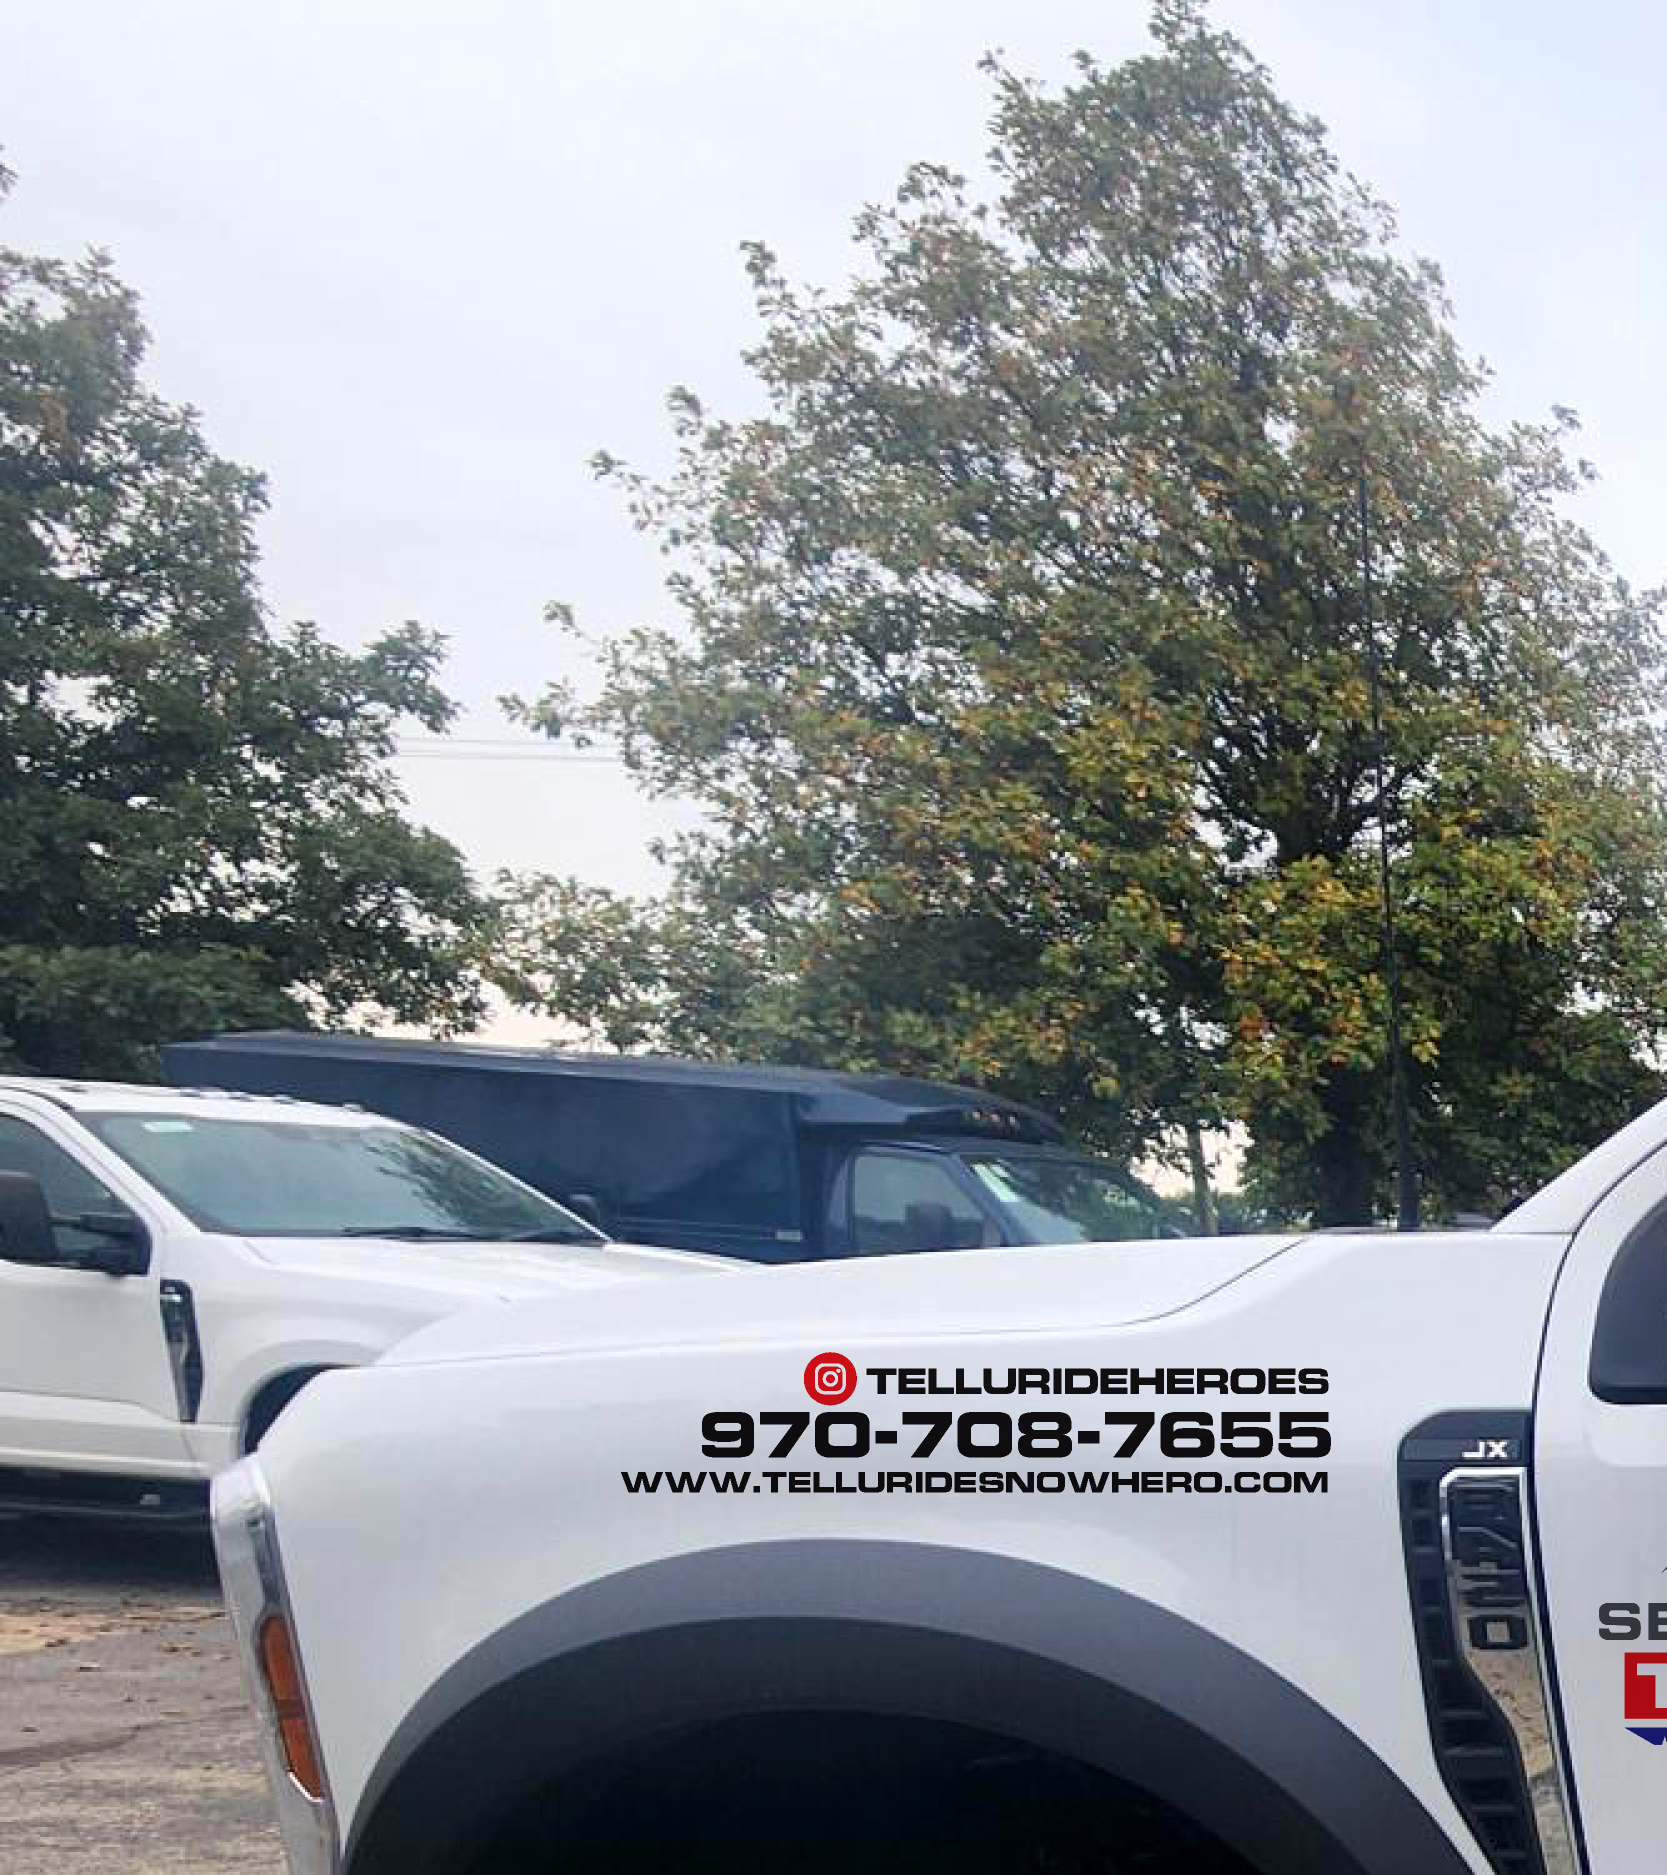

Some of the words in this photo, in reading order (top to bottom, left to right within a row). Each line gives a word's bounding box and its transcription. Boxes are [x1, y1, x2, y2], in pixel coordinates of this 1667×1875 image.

[867, 1367, 1329, 1395] TELLURIDEHEROES
[701, 1411, 1331, 1459] 970-708-7655
[621, 1471, 1328, 1494] WWW.TELLURIDESNOWHERO.COM
